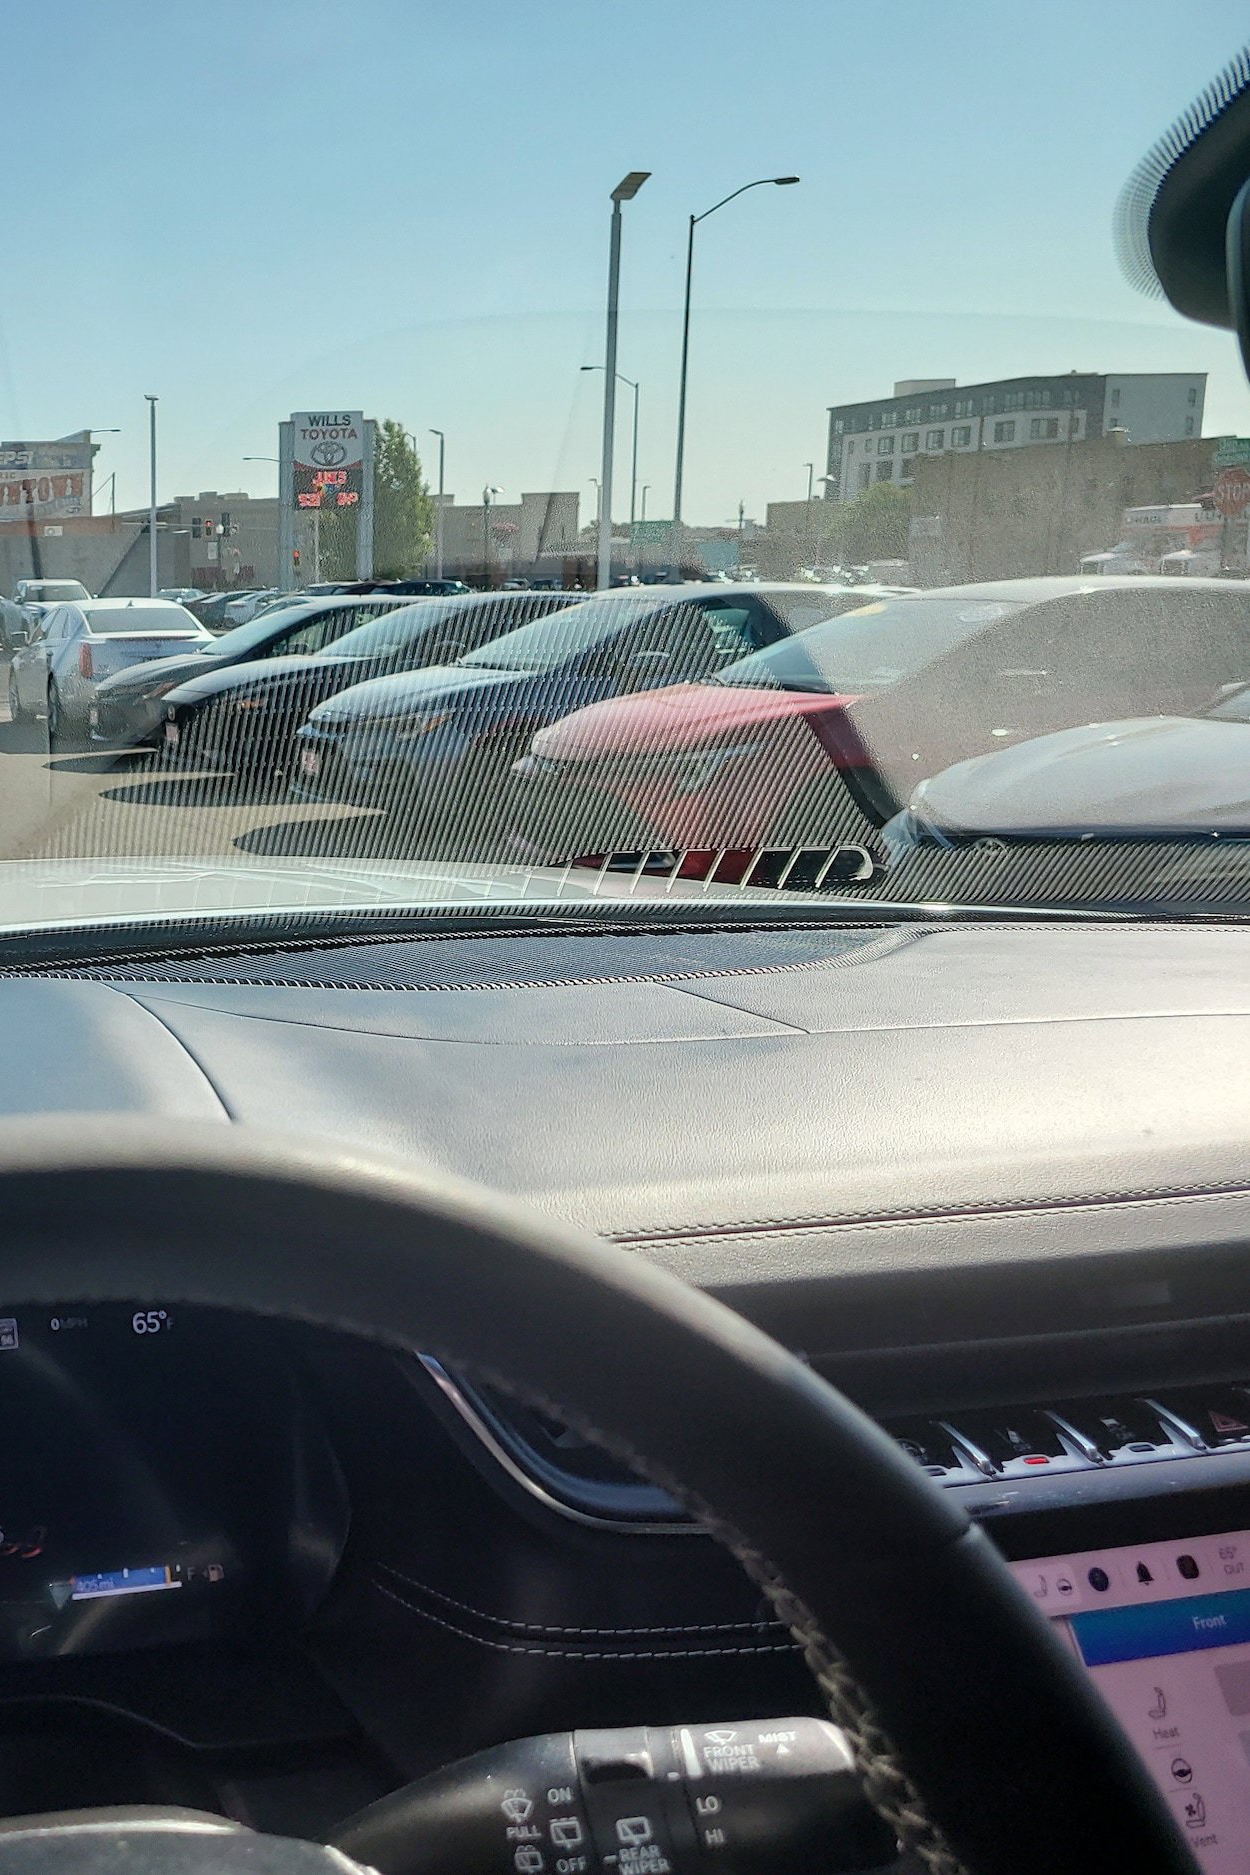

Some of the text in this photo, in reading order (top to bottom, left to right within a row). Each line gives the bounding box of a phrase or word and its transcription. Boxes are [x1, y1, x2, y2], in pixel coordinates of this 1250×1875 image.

[308, 414, 352, 427] WILLS
[301, 428, 358, 440] TOYOTA
[1192, 1615, 1227, 1630] Front
[758, 1731, 796, 1744] MIST
[1153, 1726, 1180, 1739] Heat
[703, 1744, 754, 1758] FRONT
[708, 1756, 761, 1772] WIPER
[547, 1787, 573, 1804] ON
[696, 1796, 720, 1813] LO
[505, 1825, 542, 1840] PULL
[704, 1829, 725, 1844] HI
[618, 1845, 662, 1861] REAR
[556, 1856, 587, 1873] OFF
[619, 1858, 671, 1875] WIPER
